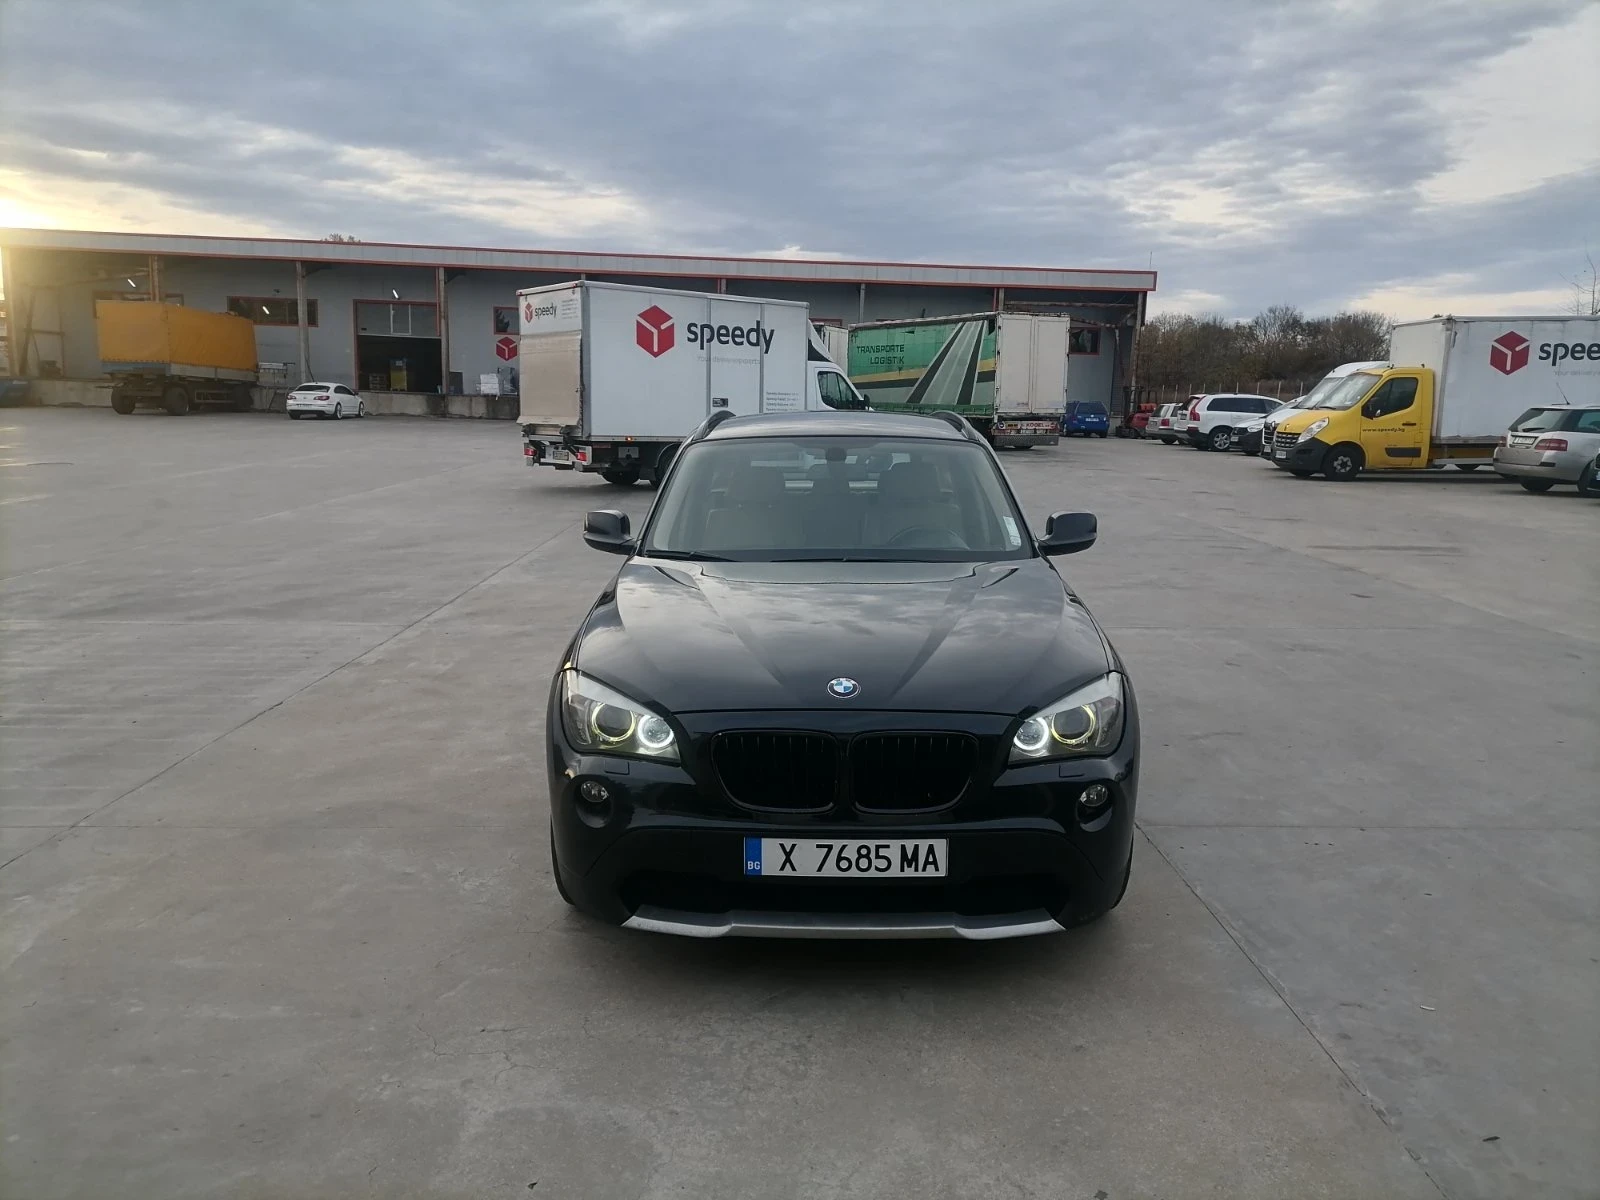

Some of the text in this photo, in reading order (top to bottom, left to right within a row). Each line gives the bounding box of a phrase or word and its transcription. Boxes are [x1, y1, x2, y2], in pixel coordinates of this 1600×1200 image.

[534, 302, 557, 319] speedy
[687, 320, 775, 354] speedy
[856, 344, 905, 354] TRANSPORTE
[1538, 342, 1600, 366] spee
[747, 861, 761, 870] BG
[779, 842, 940, 873] X 7685 MA
